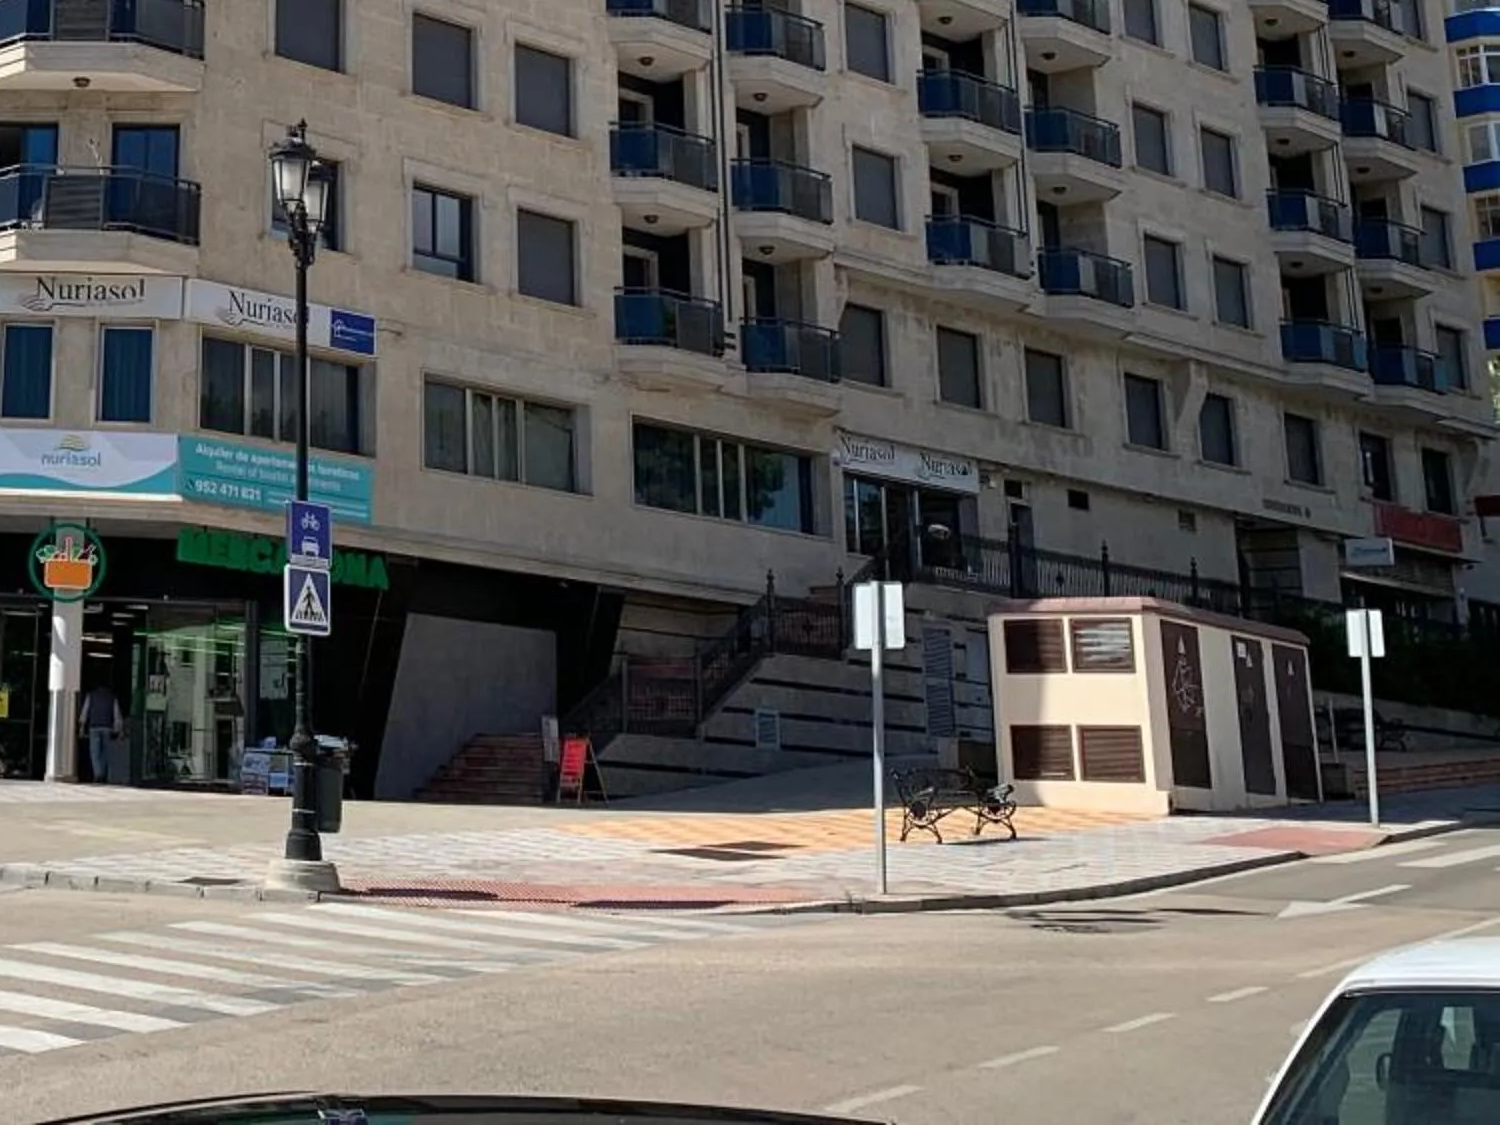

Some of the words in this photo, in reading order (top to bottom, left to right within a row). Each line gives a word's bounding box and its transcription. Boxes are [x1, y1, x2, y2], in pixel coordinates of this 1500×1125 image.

[37, 276, 145, 301] Nuriasol
[840, 433, 895, 461] Nuriasol
[41, 450, 102, 467] nuriasol
[195, 478, 217, 494] 952
[219, 482, 239, 498] 471
